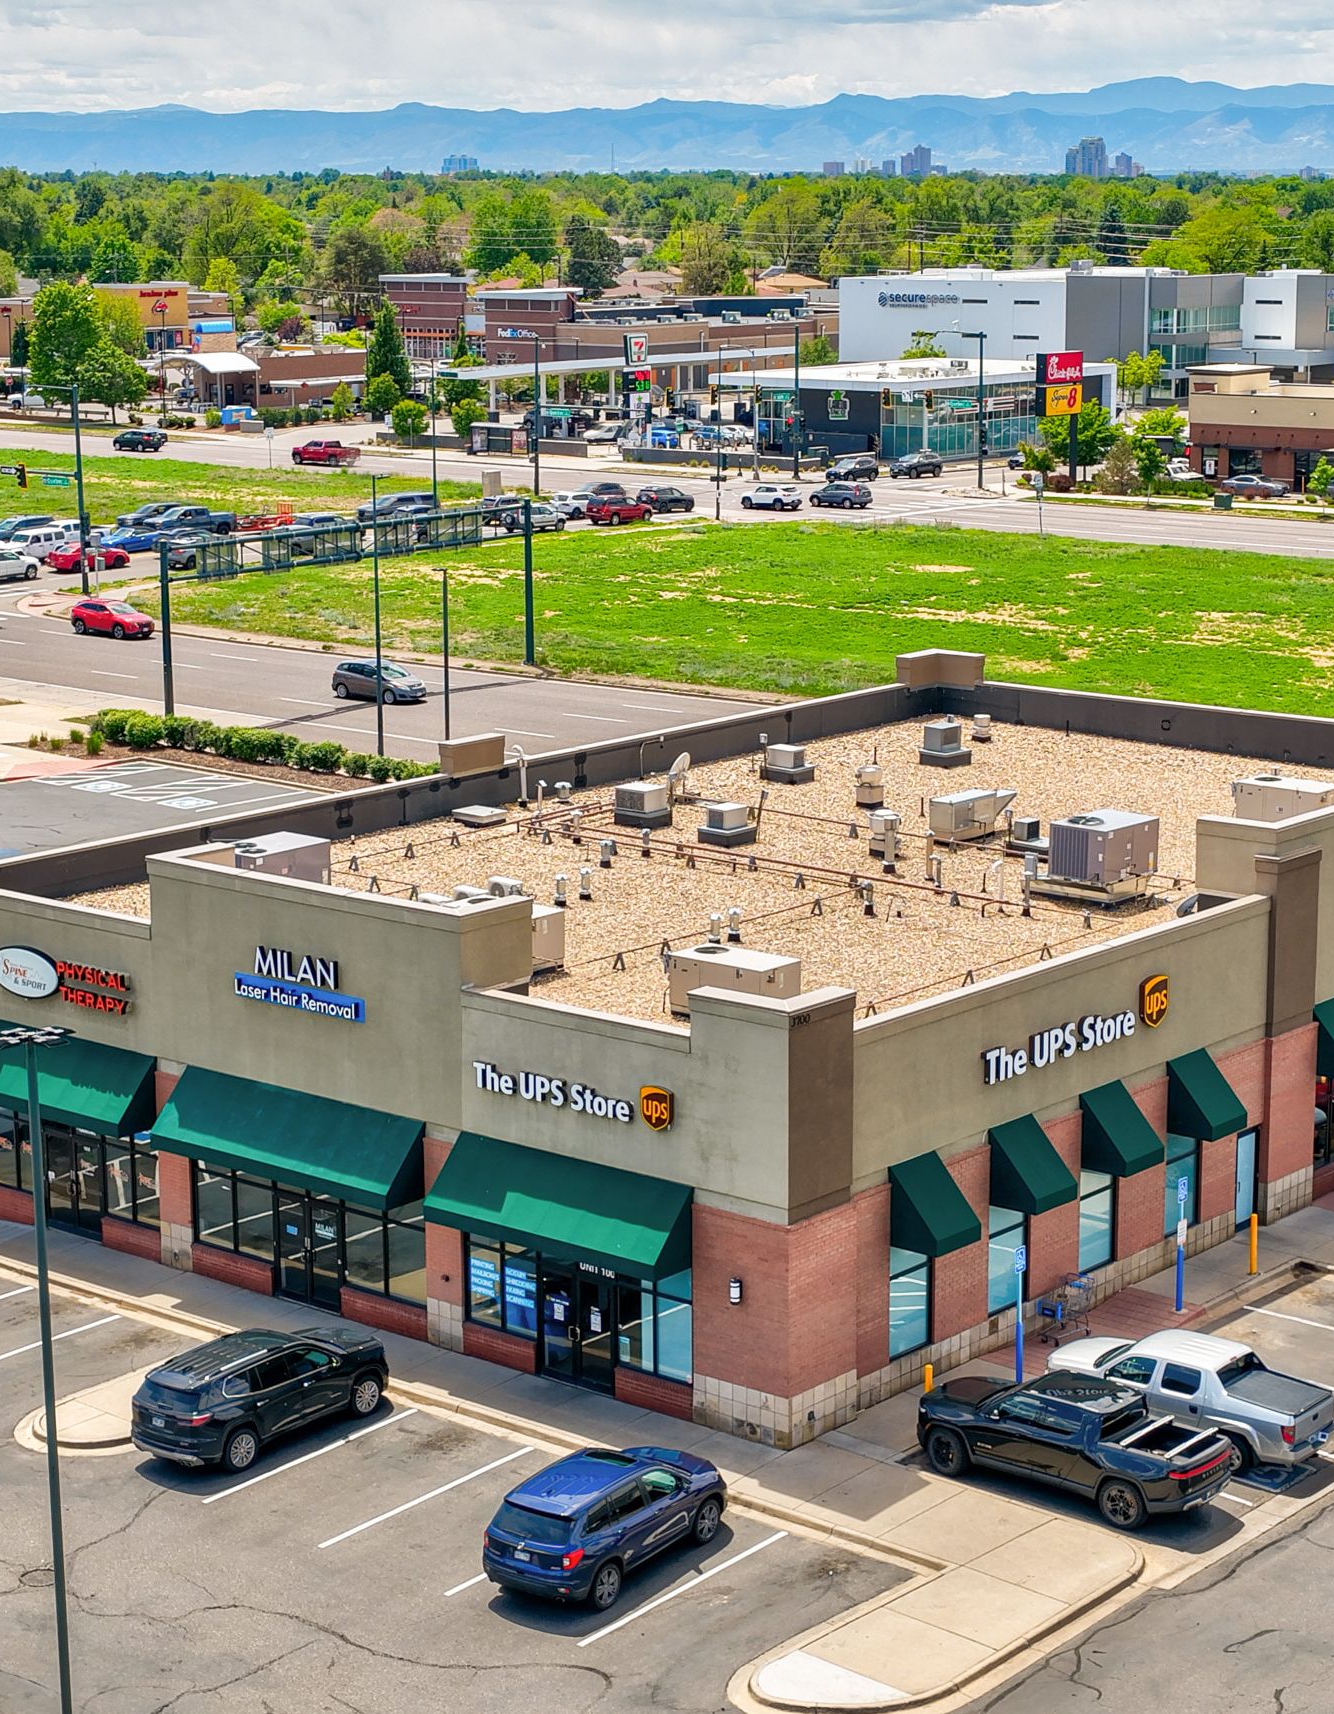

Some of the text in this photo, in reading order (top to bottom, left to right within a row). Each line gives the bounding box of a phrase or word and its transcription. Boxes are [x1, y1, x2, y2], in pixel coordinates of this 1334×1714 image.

[1067, 387, 1077, 408] 8
[56, 960, 127, 992] PHYSICAL
[254, 946, 337, 990] MILAN
[21, 978, 47, 991] SPORT
[234, 978, 356, 1020] Laser Hair Removal
[58, 985, 125, 1016] THERAPY
[1146, 989, 1168, 1020] ups
[985, 1010, 1136, 1086] The UPS Store
[472, 1060, 631, 1123] The UPS Store
[643, 1098, 668, 1124] ups
